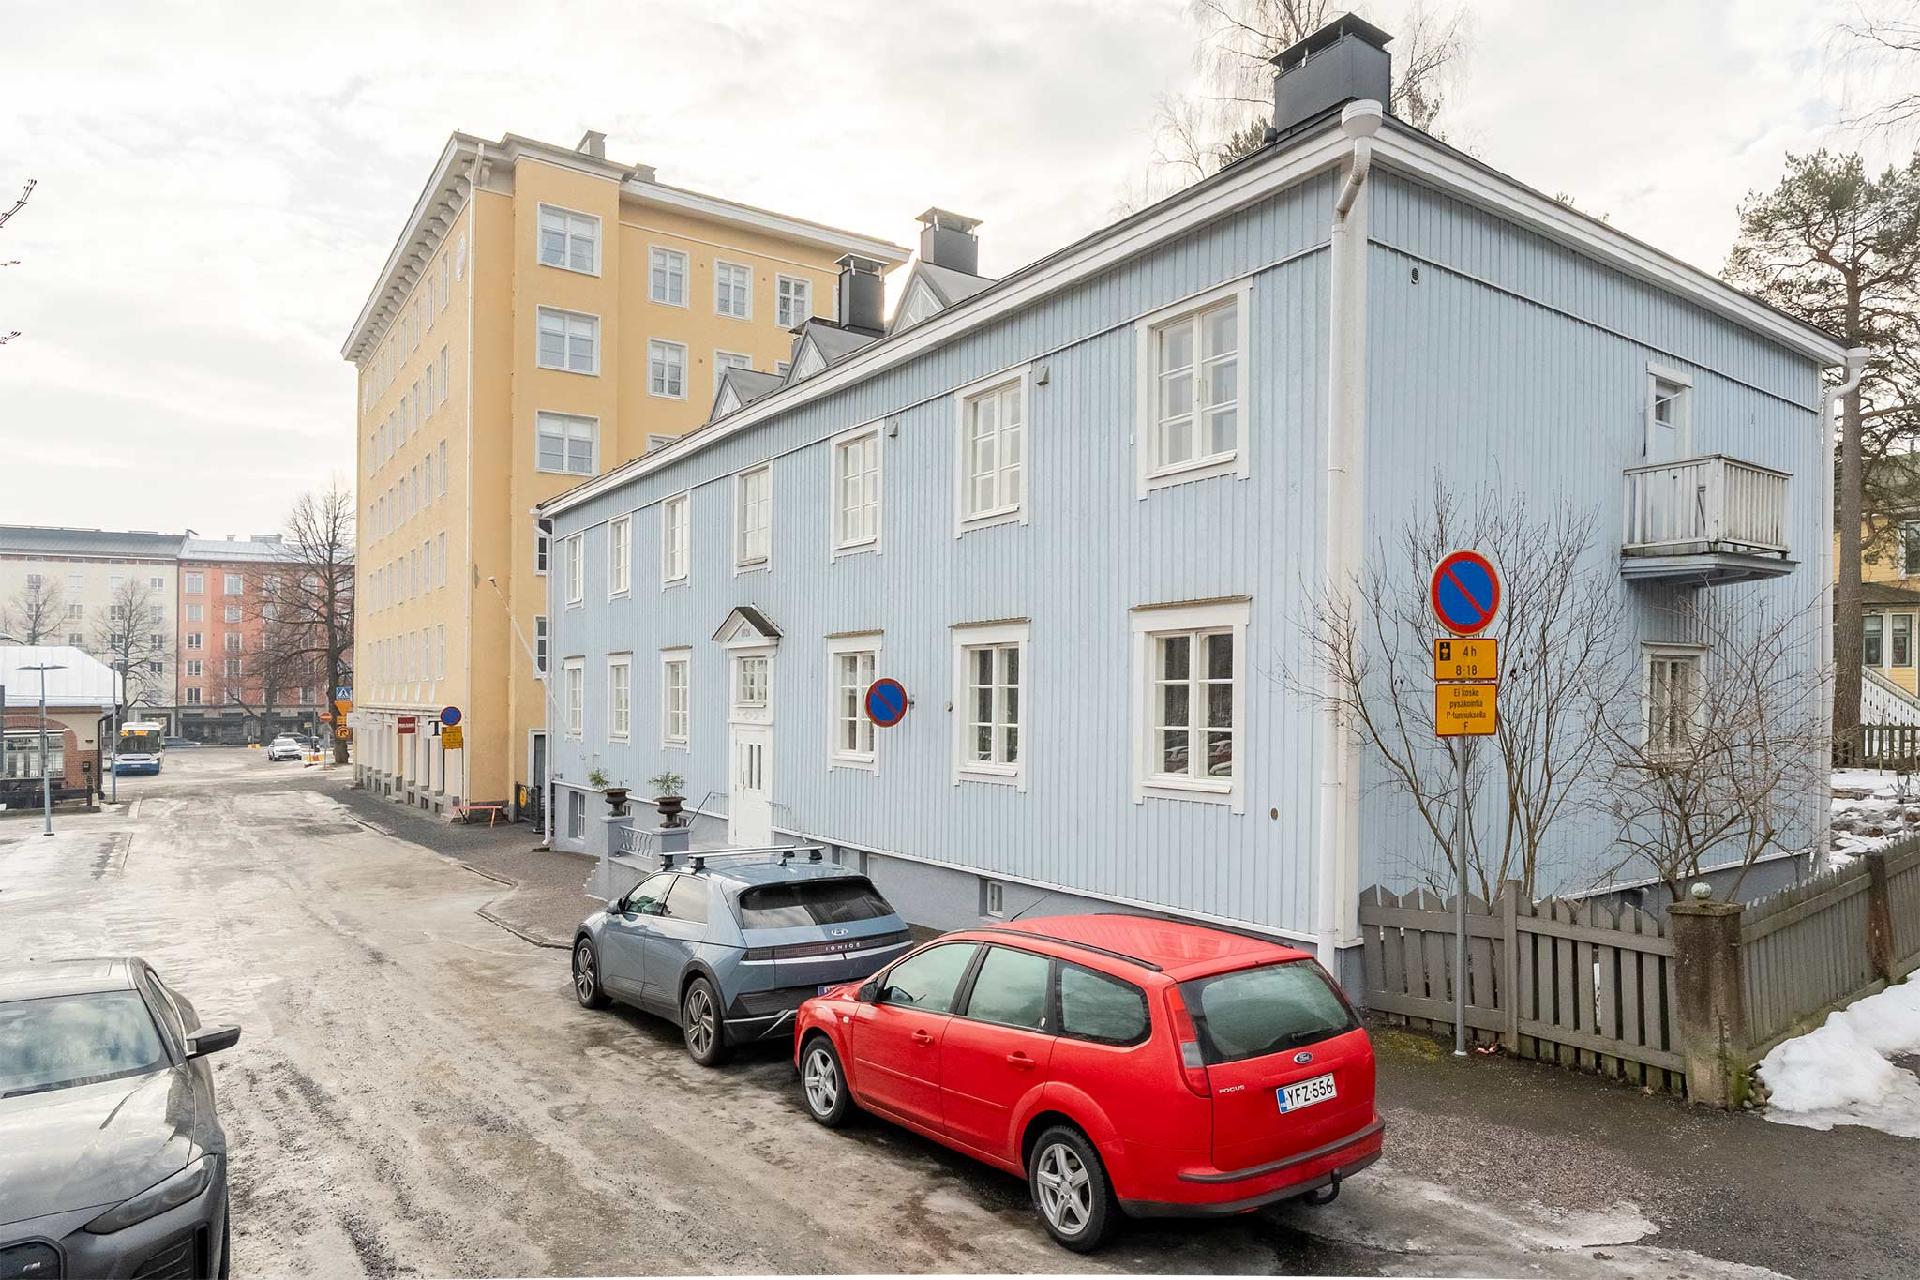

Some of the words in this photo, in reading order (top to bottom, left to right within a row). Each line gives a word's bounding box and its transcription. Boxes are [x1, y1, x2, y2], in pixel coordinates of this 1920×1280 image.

[1462, 646, 1469, 657] 4
[1471, 646, 1477, 657] h
[1463, 721, 1469, 731] F
[1286, 1078, 1334, 1107] YFZ-556
